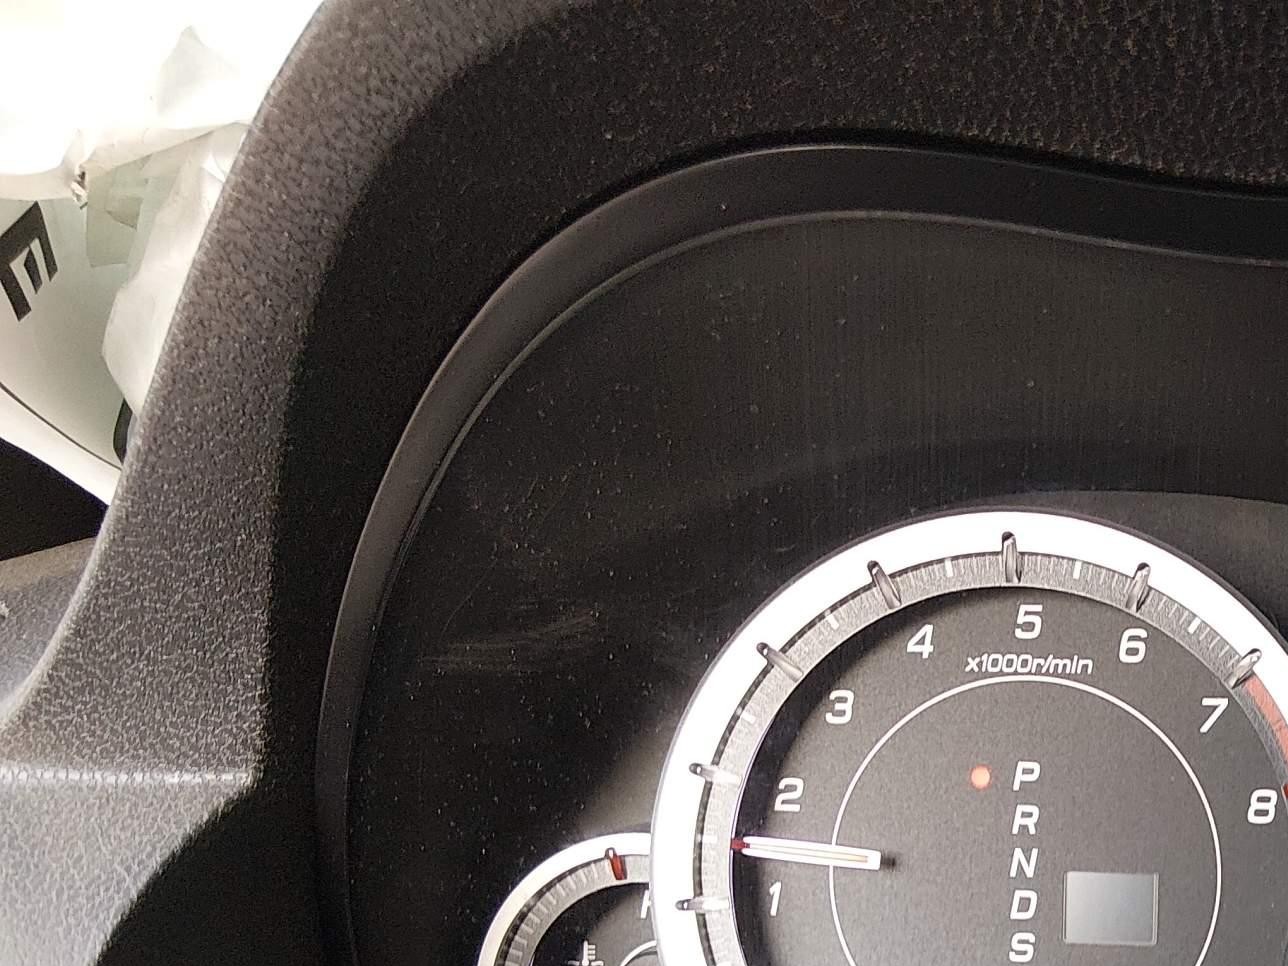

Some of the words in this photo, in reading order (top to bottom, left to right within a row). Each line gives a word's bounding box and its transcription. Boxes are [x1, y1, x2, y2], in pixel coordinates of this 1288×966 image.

[1014, 604, 1043, 639] 5
[906, 624, 934, 659] 4
[1118, 628, 1148, 664] 6
[825, 689, 855, 725] 3
[1199, 697, 1229, 733] 7
[1012, 760, 1041, 791] P
[774, 777, 804, 812] 2
[1247, 788, 1278, 824] 8
[1012, 804, 1040, 835] R
[1009, 847, 1039, 878] N
[769, 881, 782, 916] 1
[1010, 889, 1038, 920] D
[1008, 932, 1036, 963] S
